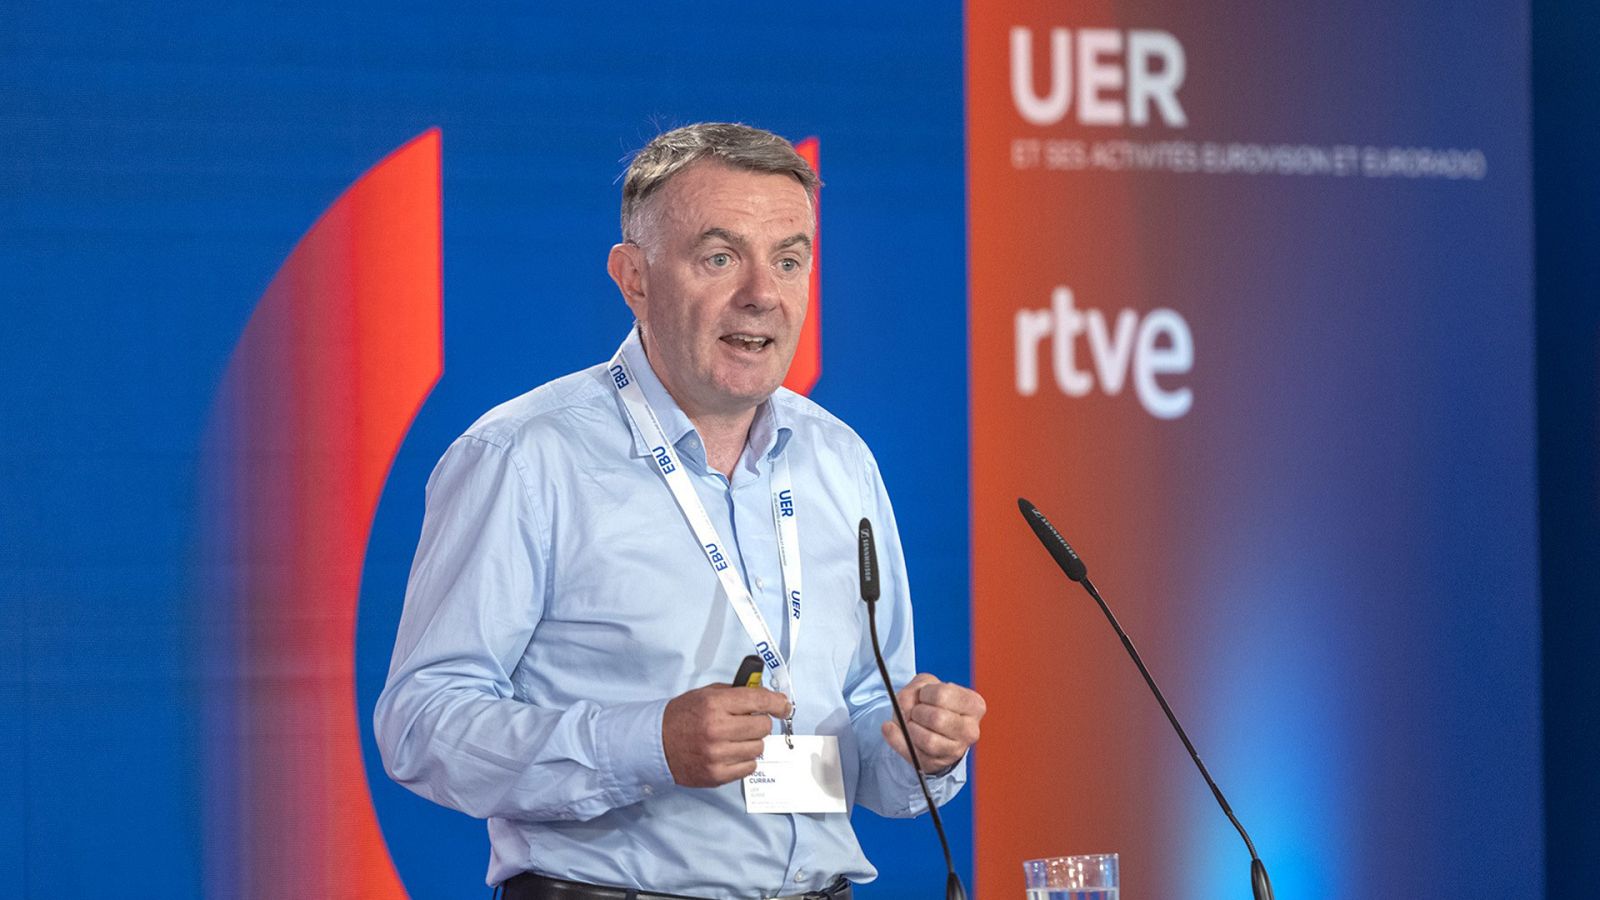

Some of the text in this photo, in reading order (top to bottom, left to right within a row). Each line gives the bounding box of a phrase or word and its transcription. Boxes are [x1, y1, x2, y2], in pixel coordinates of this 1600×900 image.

[1010, 27, 1188, 128] UER
[1011, 139, 1040, 169] ET
[1045, 140, 1086, 170] SES
[1202, 142, 1329, 175] EUROVISION
[1333, 144, 1359, 177] ET
[1362, 145, 1487, 180] EURORADIO
[1015, 286, 1194, 419] rtve
[610, 364, 629, 390] EBU
[652, 446, 676, 475] EBU
[779, 489, 794, 518] UER
[705, 543, 728, 572] EBU
[791, 589, 801, 620] UER
[756, 641, 780, 670] EBU
